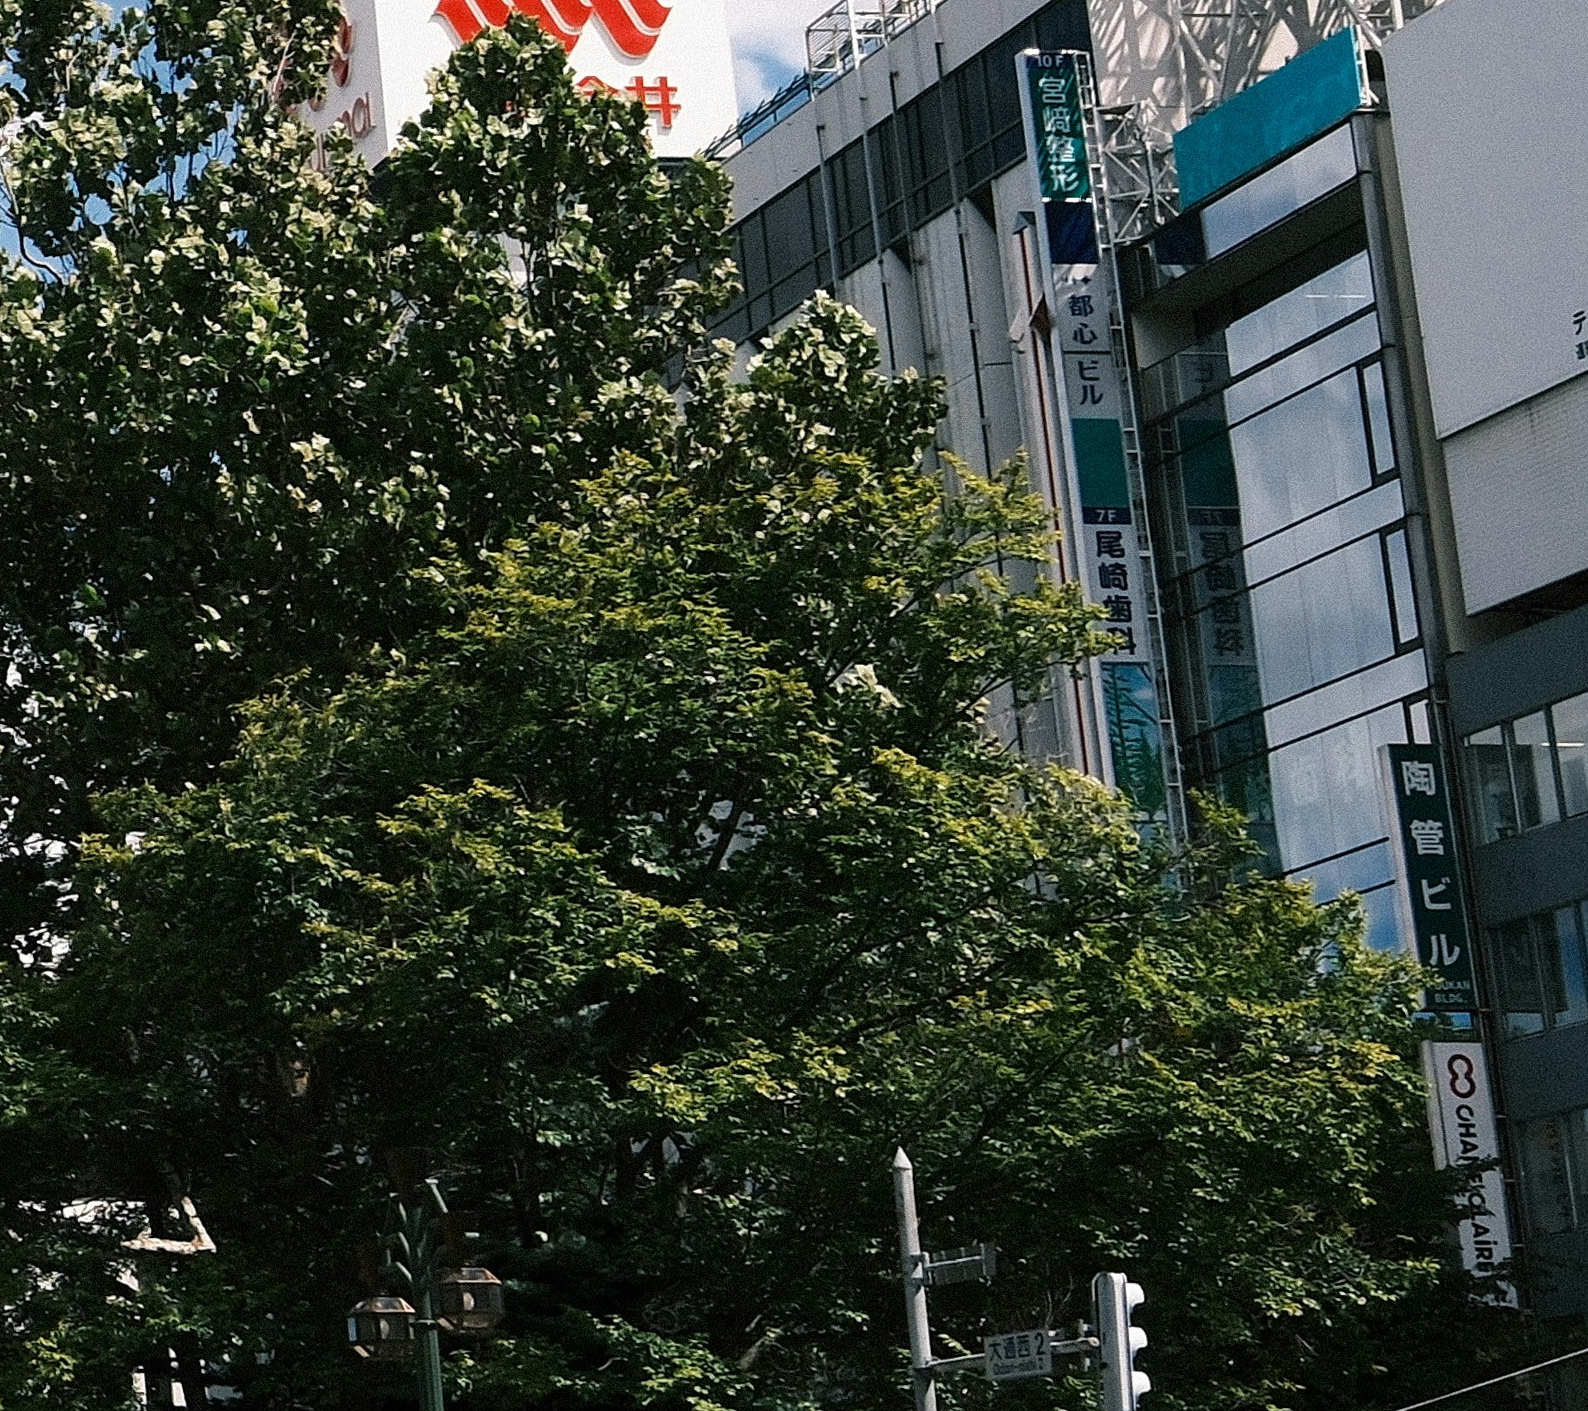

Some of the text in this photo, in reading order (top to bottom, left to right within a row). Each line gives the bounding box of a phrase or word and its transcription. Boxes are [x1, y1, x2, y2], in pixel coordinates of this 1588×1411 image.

[1068, 294, 1104, 405] 都心ビル
[1095, 509, 1118, 522] 7F
[1401, 760, 1460, 967] 陶管ビル
